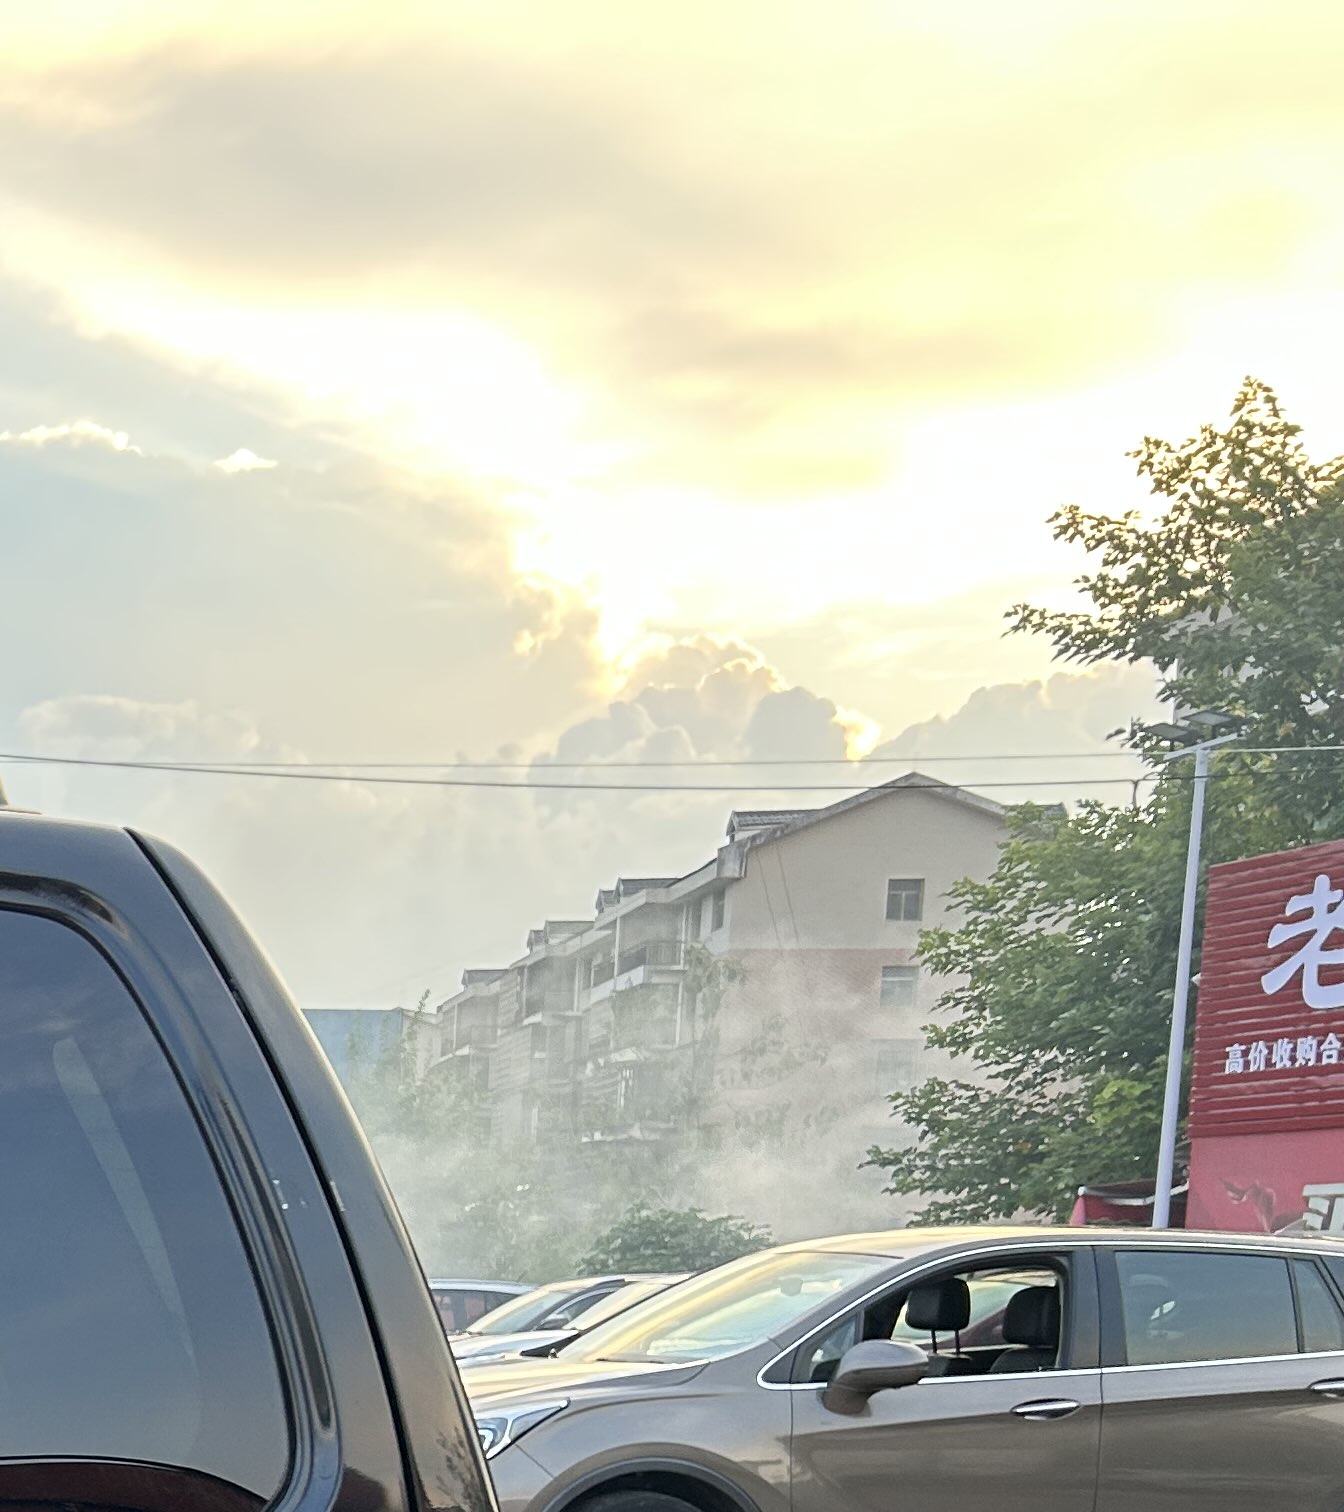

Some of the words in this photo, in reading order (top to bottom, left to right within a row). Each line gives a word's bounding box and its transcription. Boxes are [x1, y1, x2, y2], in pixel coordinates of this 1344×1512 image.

[1261, 874, 1344, 1010] 老
[1224, 1033, 1341, 1075] 高价收购合
